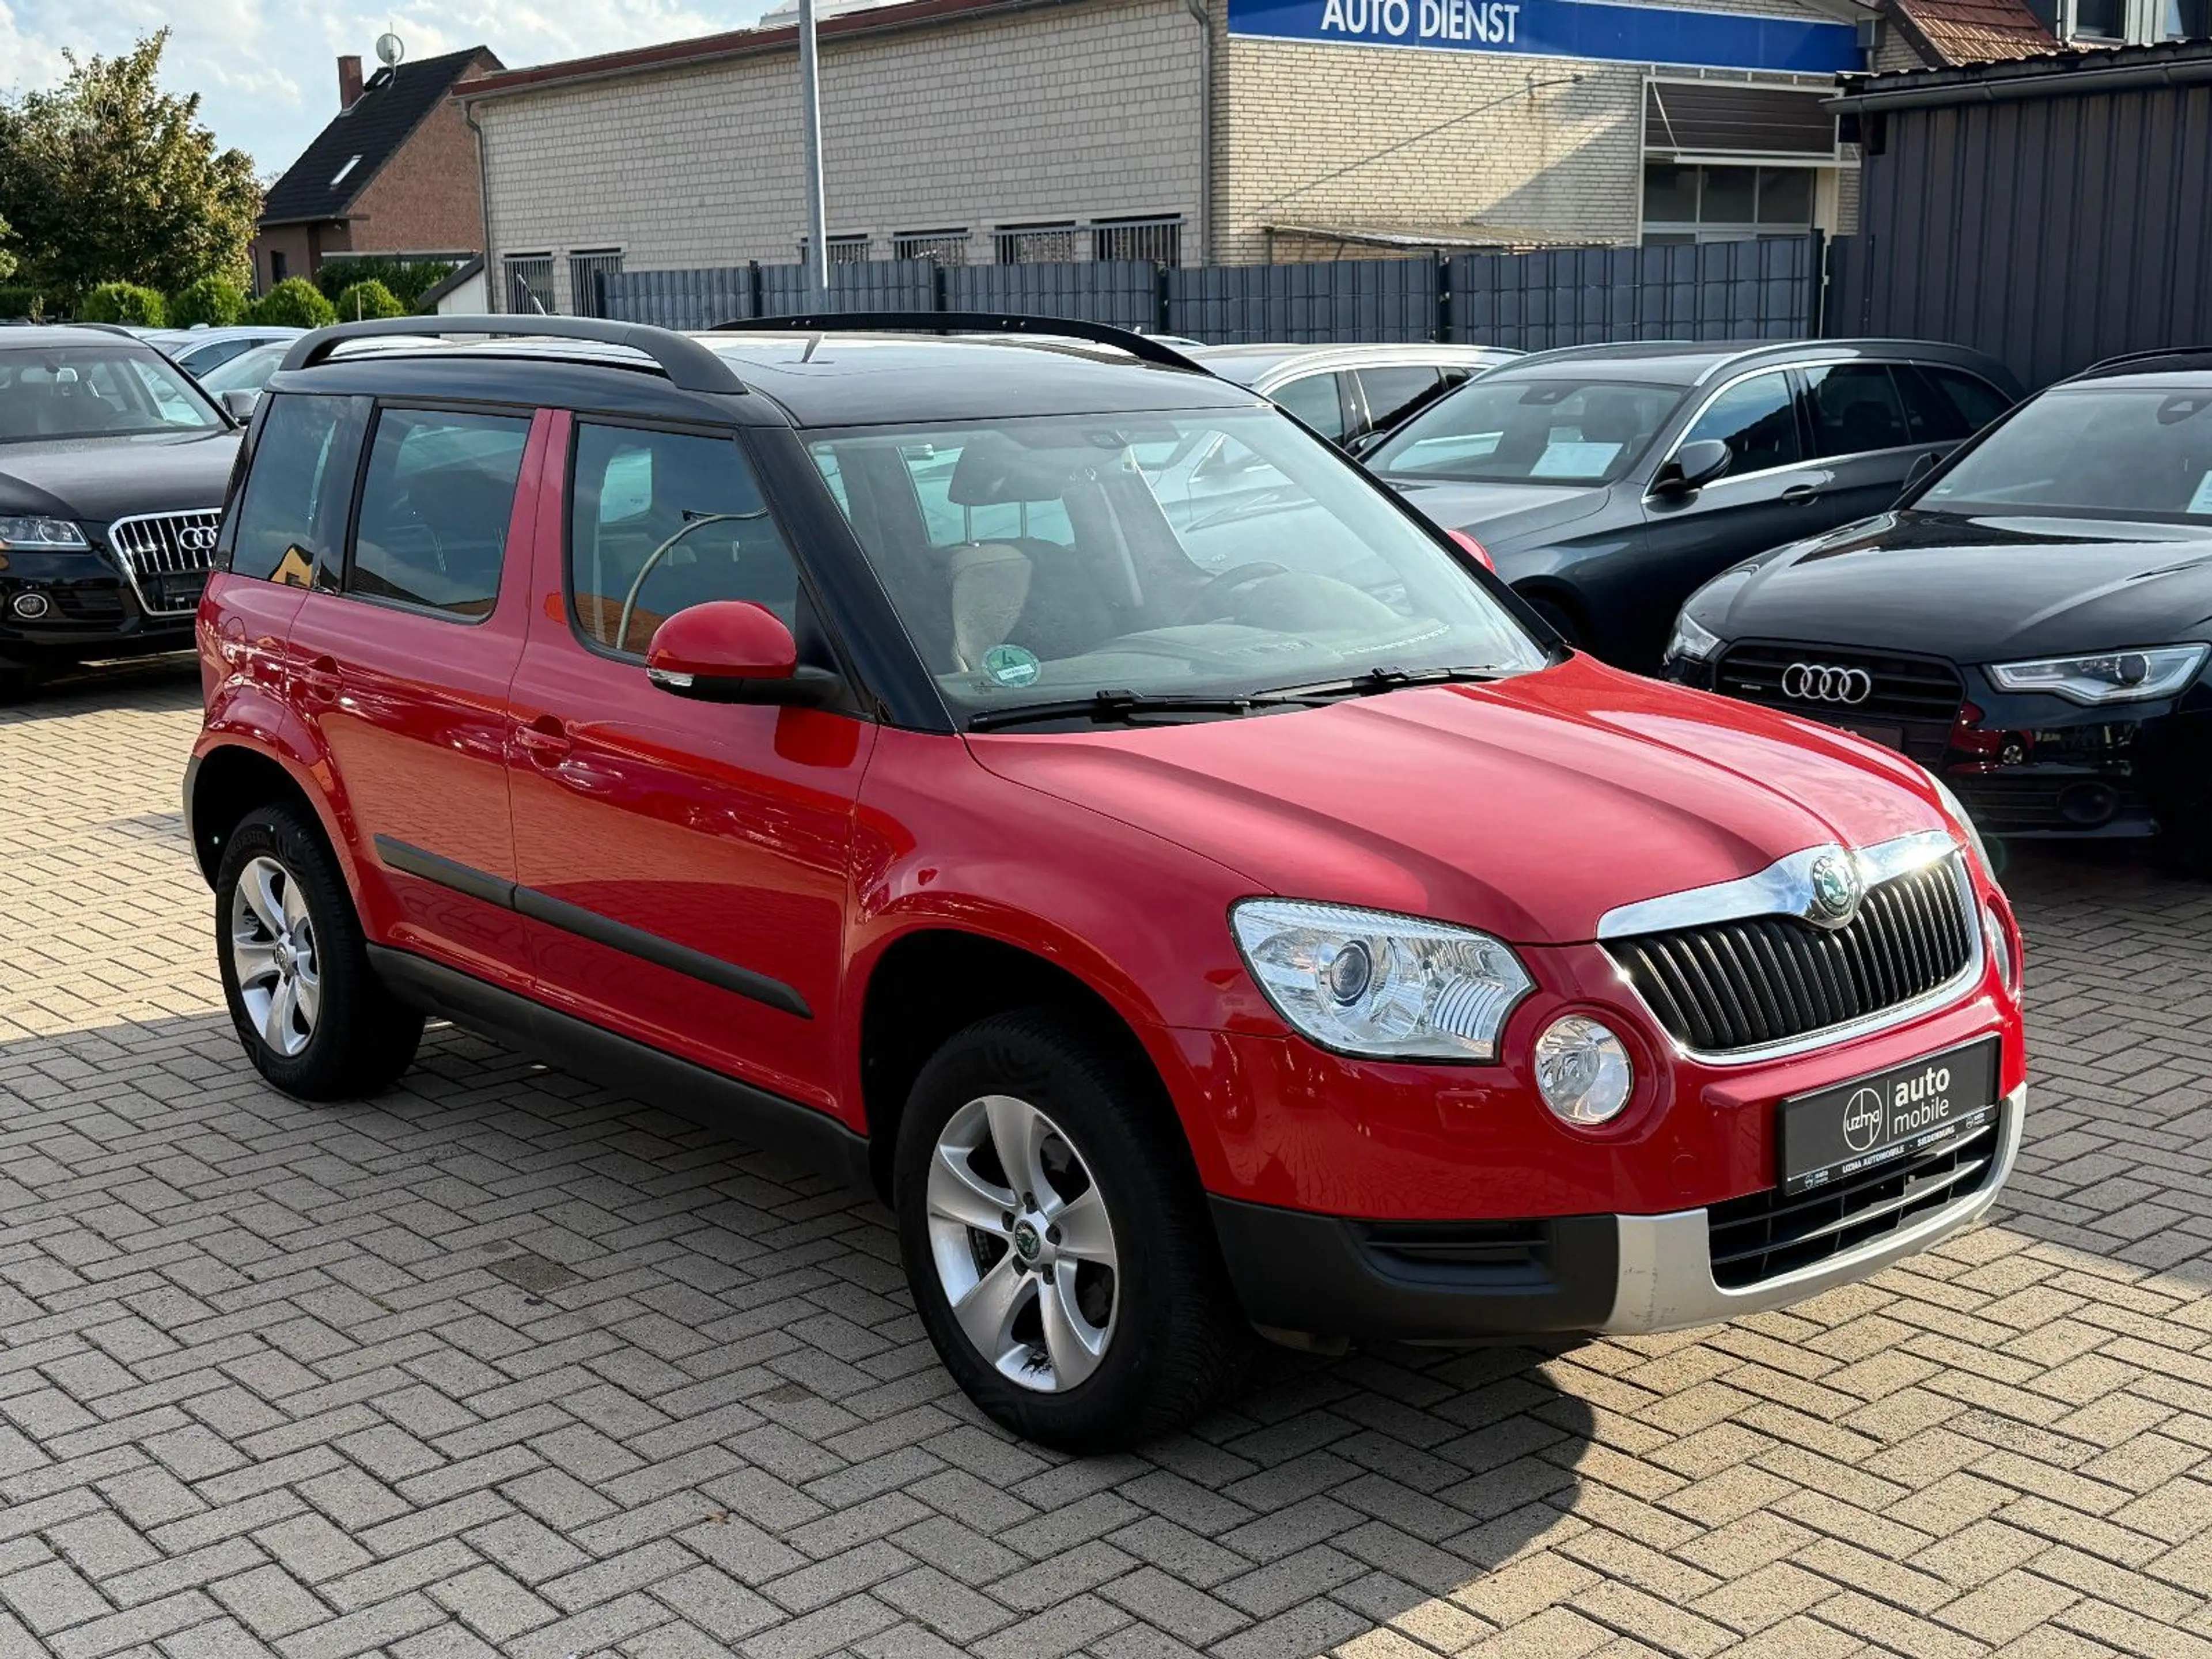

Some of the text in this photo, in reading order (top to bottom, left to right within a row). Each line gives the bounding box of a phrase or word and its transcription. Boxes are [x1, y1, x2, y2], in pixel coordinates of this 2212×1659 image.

[1320, 0, 1520, 43] AUTO DIENST
[1895, 1067, 1950, 1107] auto
[1893, 1096, 1949, 1134] mobile
[1863, 1145, 1904, 1165] AUTOMOBILE
